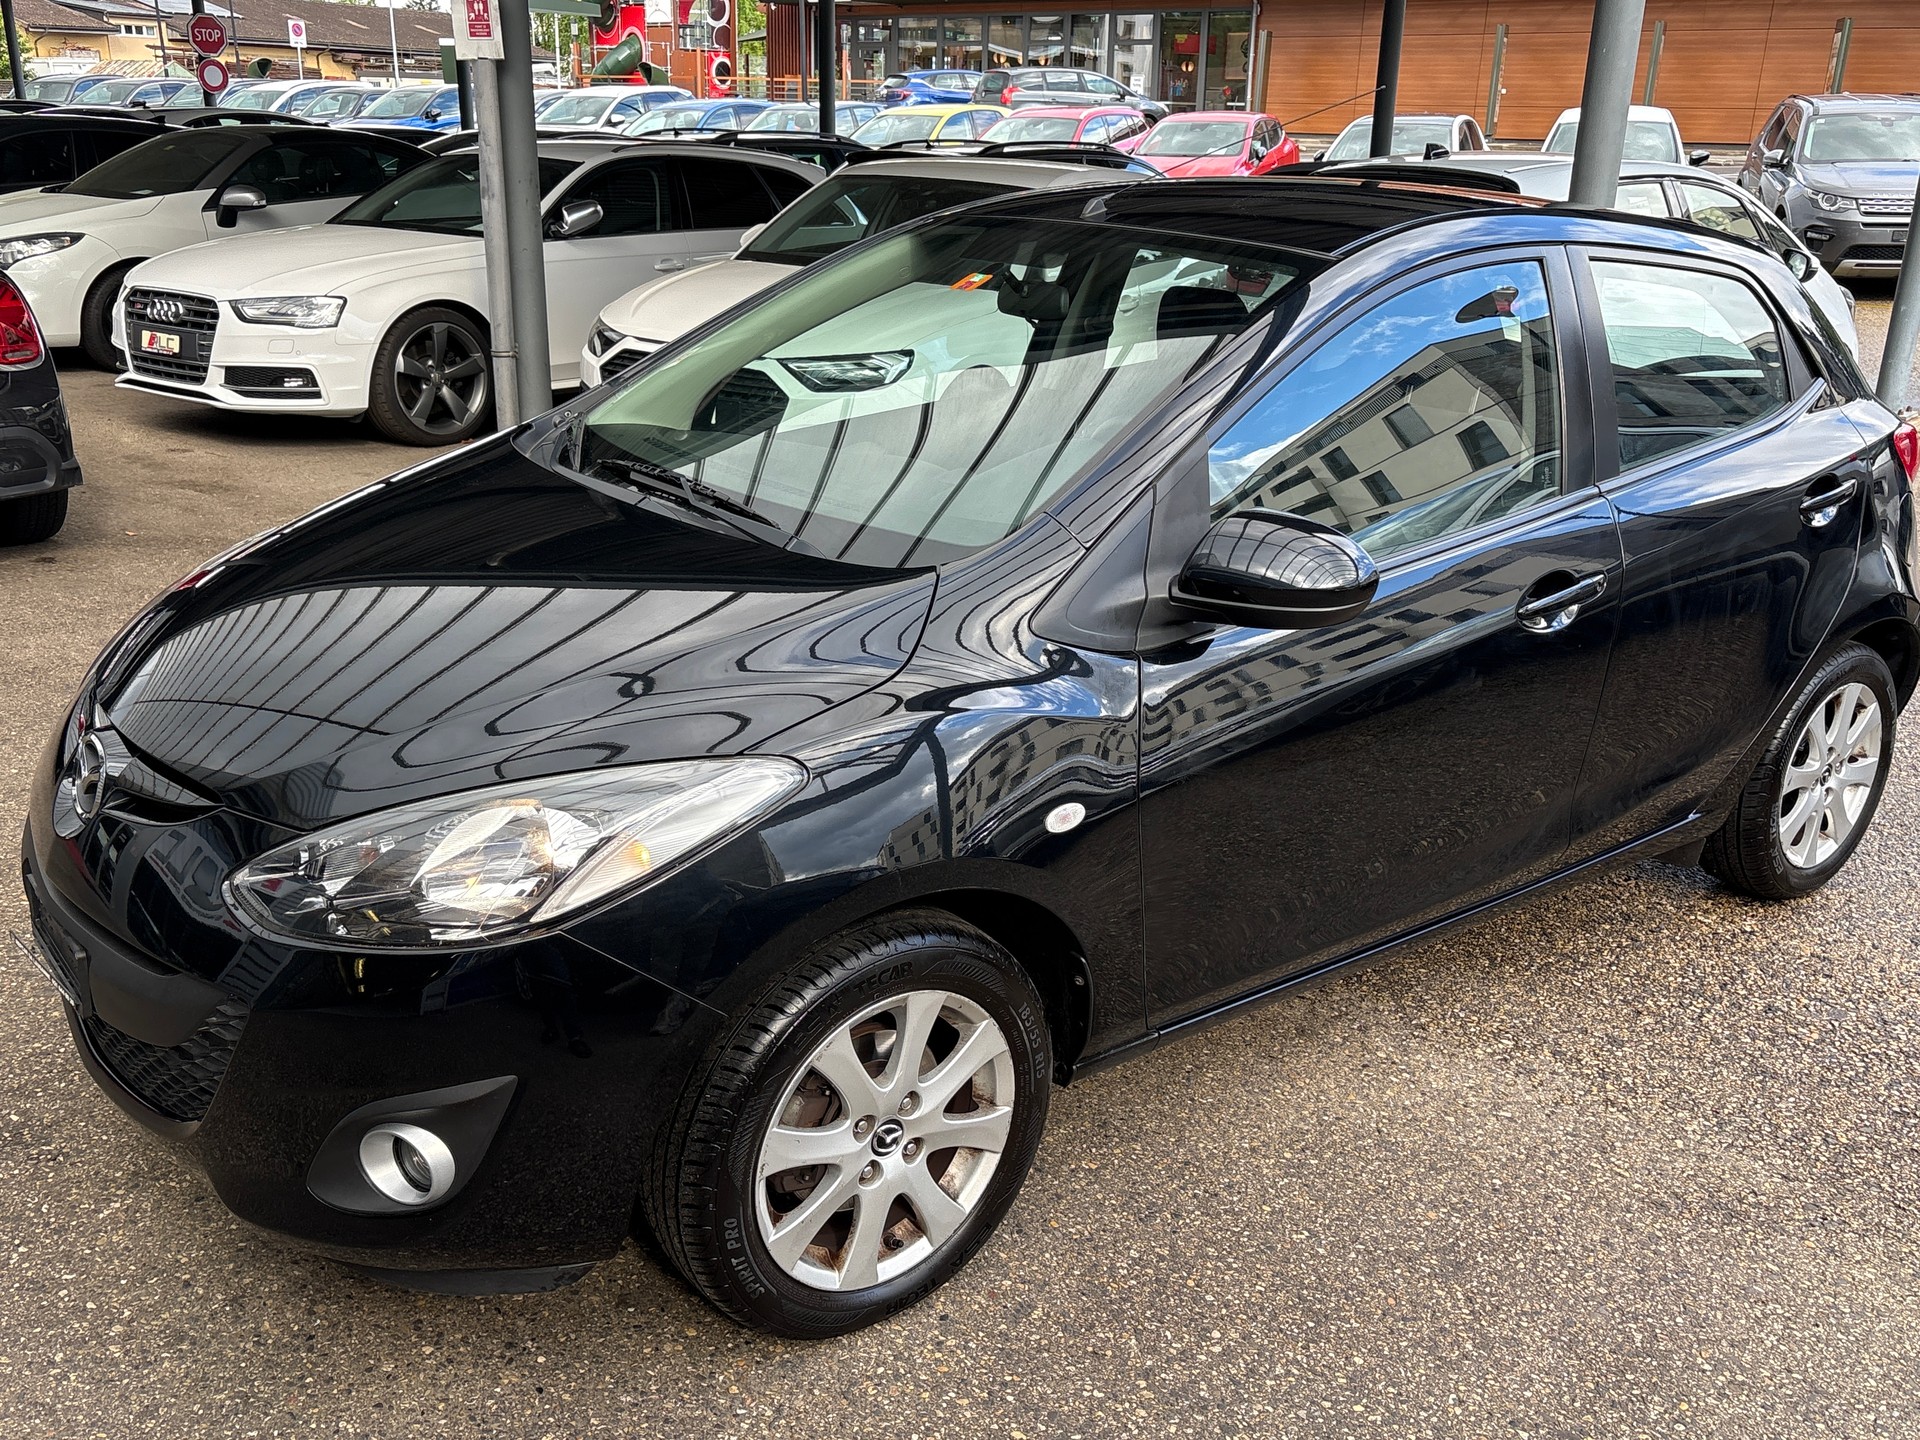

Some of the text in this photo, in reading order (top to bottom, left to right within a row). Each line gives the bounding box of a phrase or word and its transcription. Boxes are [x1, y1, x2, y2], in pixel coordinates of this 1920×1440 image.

[194, 28, 221, 43] STOP
[853, 961, 914, 999] TECAR
[1018, 1001, 1042, 1049] 185/55
[1034, 1051, 1046, 1079] R15
[723, 1218, 766, 1299] SPIRIT PRO
